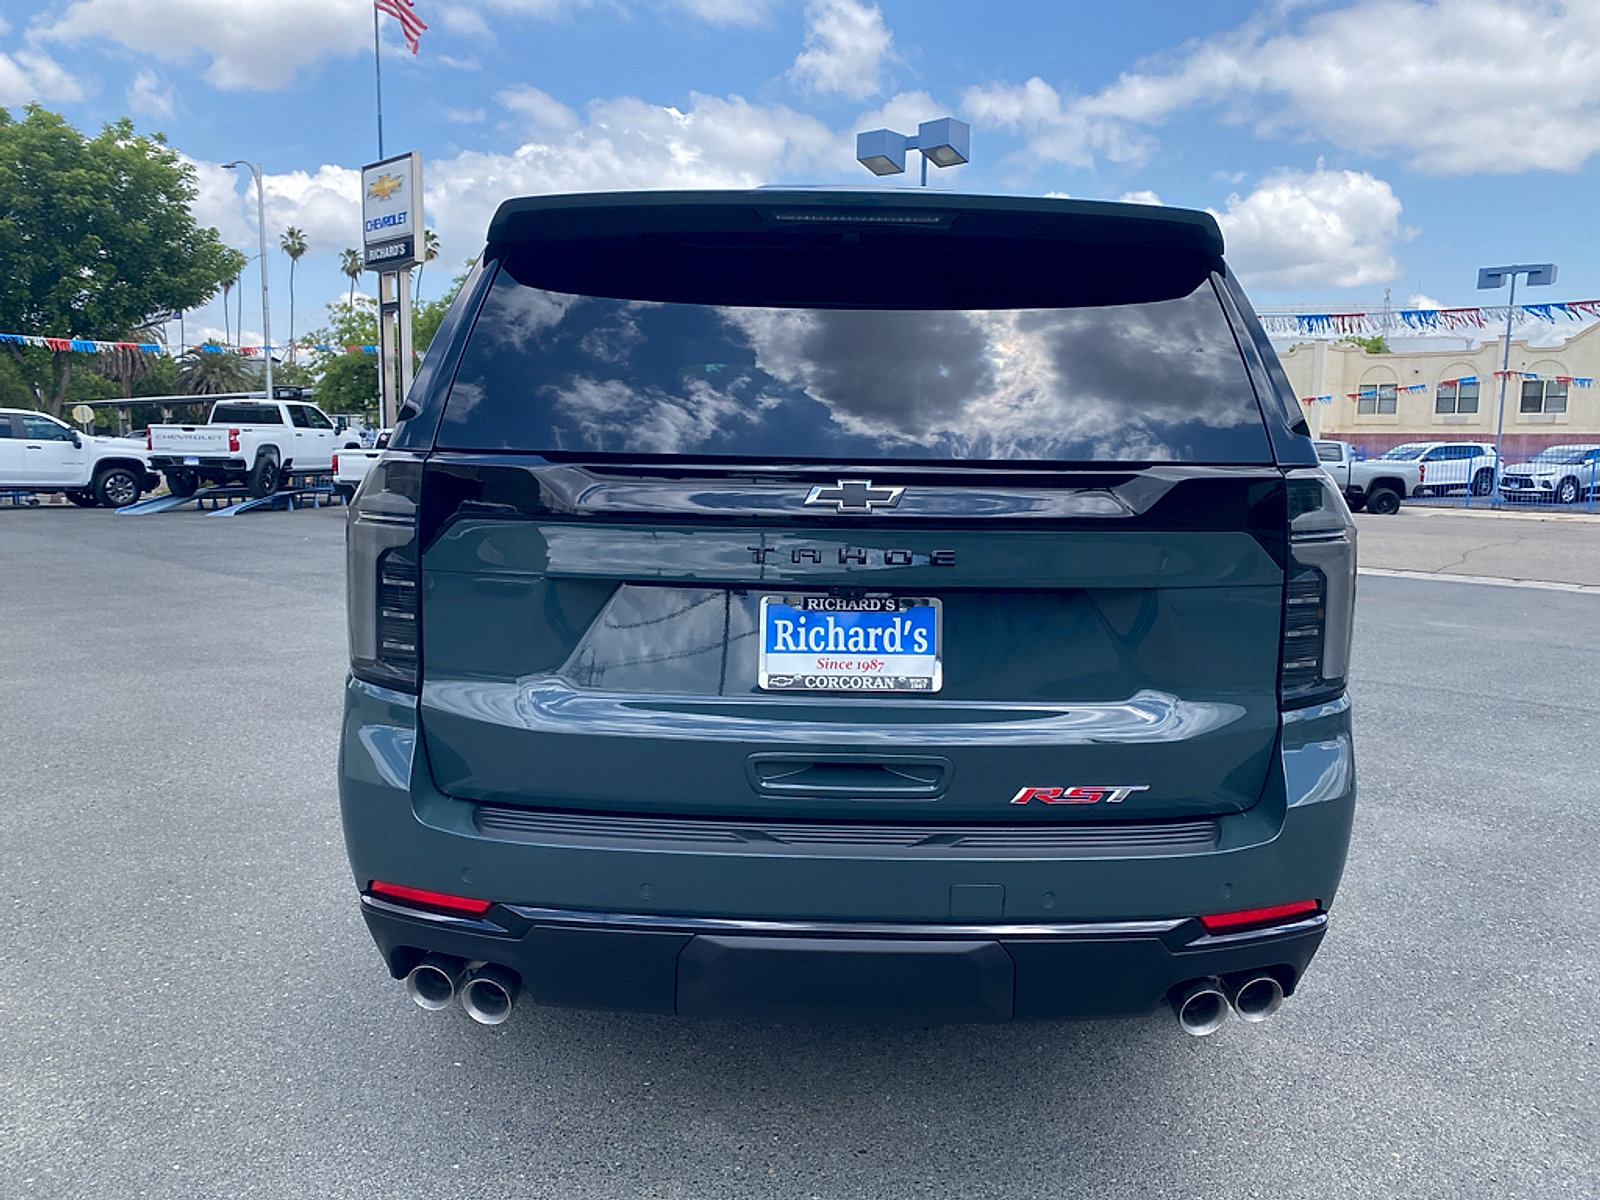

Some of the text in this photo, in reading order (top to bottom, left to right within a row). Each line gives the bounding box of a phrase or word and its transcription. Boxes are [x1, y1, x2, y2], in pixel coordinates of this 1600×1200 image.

[747, 546, 955, 566] TAHOE
[807, 598, 896, 611] RICHARD'S
[773, 616, 928, 653] Richard's
[816, 658, 885, 672] Since 1987
[804, 676, 894, 689] CORCORAN
[1010, 785, 1150, 804] RST
